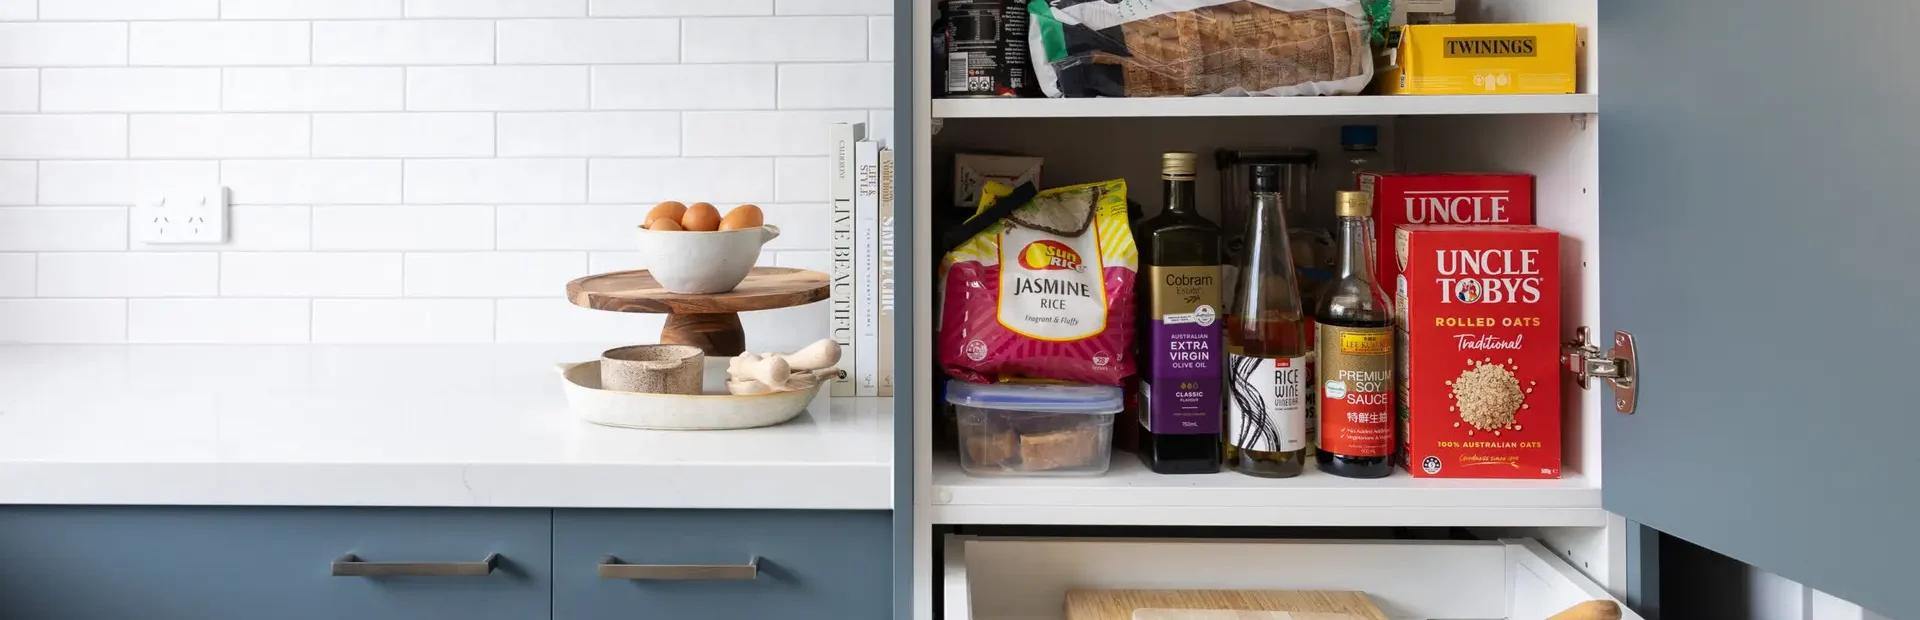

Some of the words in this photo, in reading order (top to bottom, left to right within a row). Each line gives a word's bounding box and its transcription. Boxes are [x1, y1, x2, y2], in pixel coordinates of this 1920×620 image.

[1447, 38, 1533, 55] TWININGS
[860, 164, 869, 196] STYLE
[868, 164, 876, 187] LIFE
[1404, 196, 1509, 223] UNCLE
[834, 198, 850, 240] LIVE
[1045, 245, 1077, 261] Sun
[1436, 249, 1540, 276] UNCLE
[1166, 273, 1213, 286] Cobram
[1014, 277, 1091, 298] JASMINE
[1040, 298, 1066, 310] RICE
[1025, 314, 1052, 325] Fragrant
[1060, 316, 1080, 327] Fluffy
[1435, 317, 1496, 327] ROLLED
[1501, 316, 1541, 327] OATS
[1170, 341, 1208, 350] EXTRA
[1453, 333, 1523, 352] Traditional
[1169, 351, 1209, 361] VIRGIN
[1275, 369, 1299, 385] RICE
[1339, 369, 1391, 382] PREMIUM
[1355, 381, 1381, 393] SOY
[1274, 397, 1299, 407] VINEGAR
[1347, 393, 1387, 405] SAUCE
